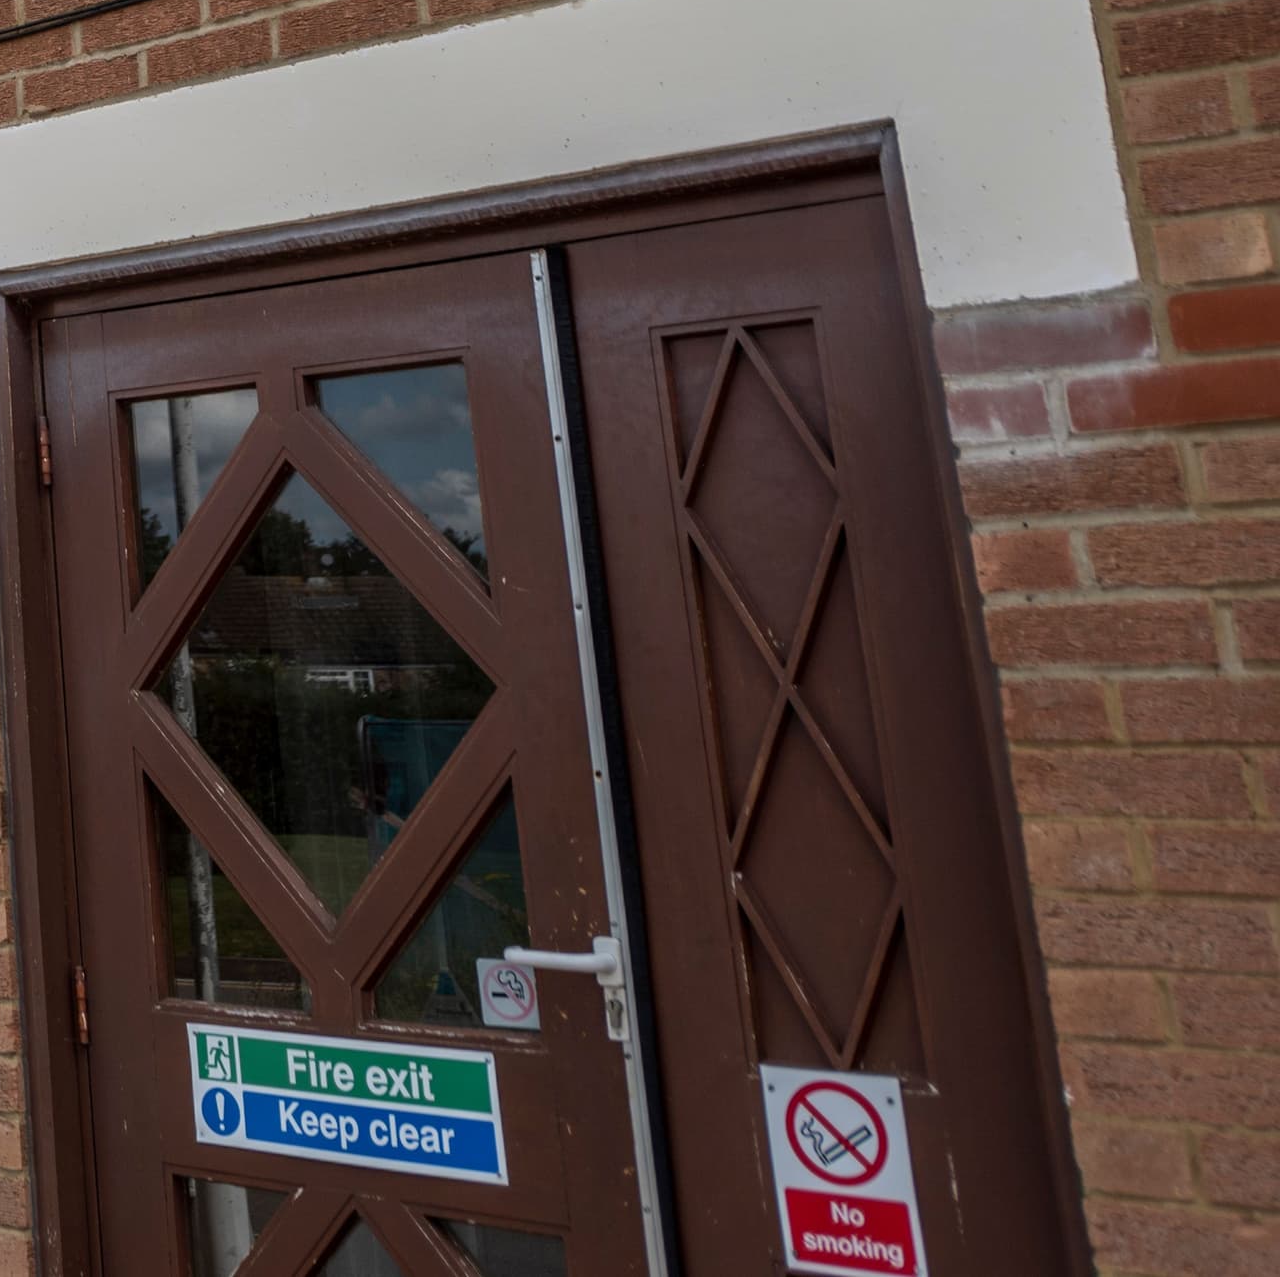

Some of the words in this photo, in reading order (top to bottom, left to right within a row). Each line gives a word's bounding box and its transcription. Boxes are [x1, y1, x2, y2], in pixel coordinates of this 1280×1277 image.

[287, 1048, 355, 1093] Fire
[365, 1060, 435, 1102] exit
[278, 1099, 360, 1150] Keep
[369, 1113, 456, 1155] clear
[830, 1201, 865, 1227] No
[802, 1232, 904, 1268] smoking
